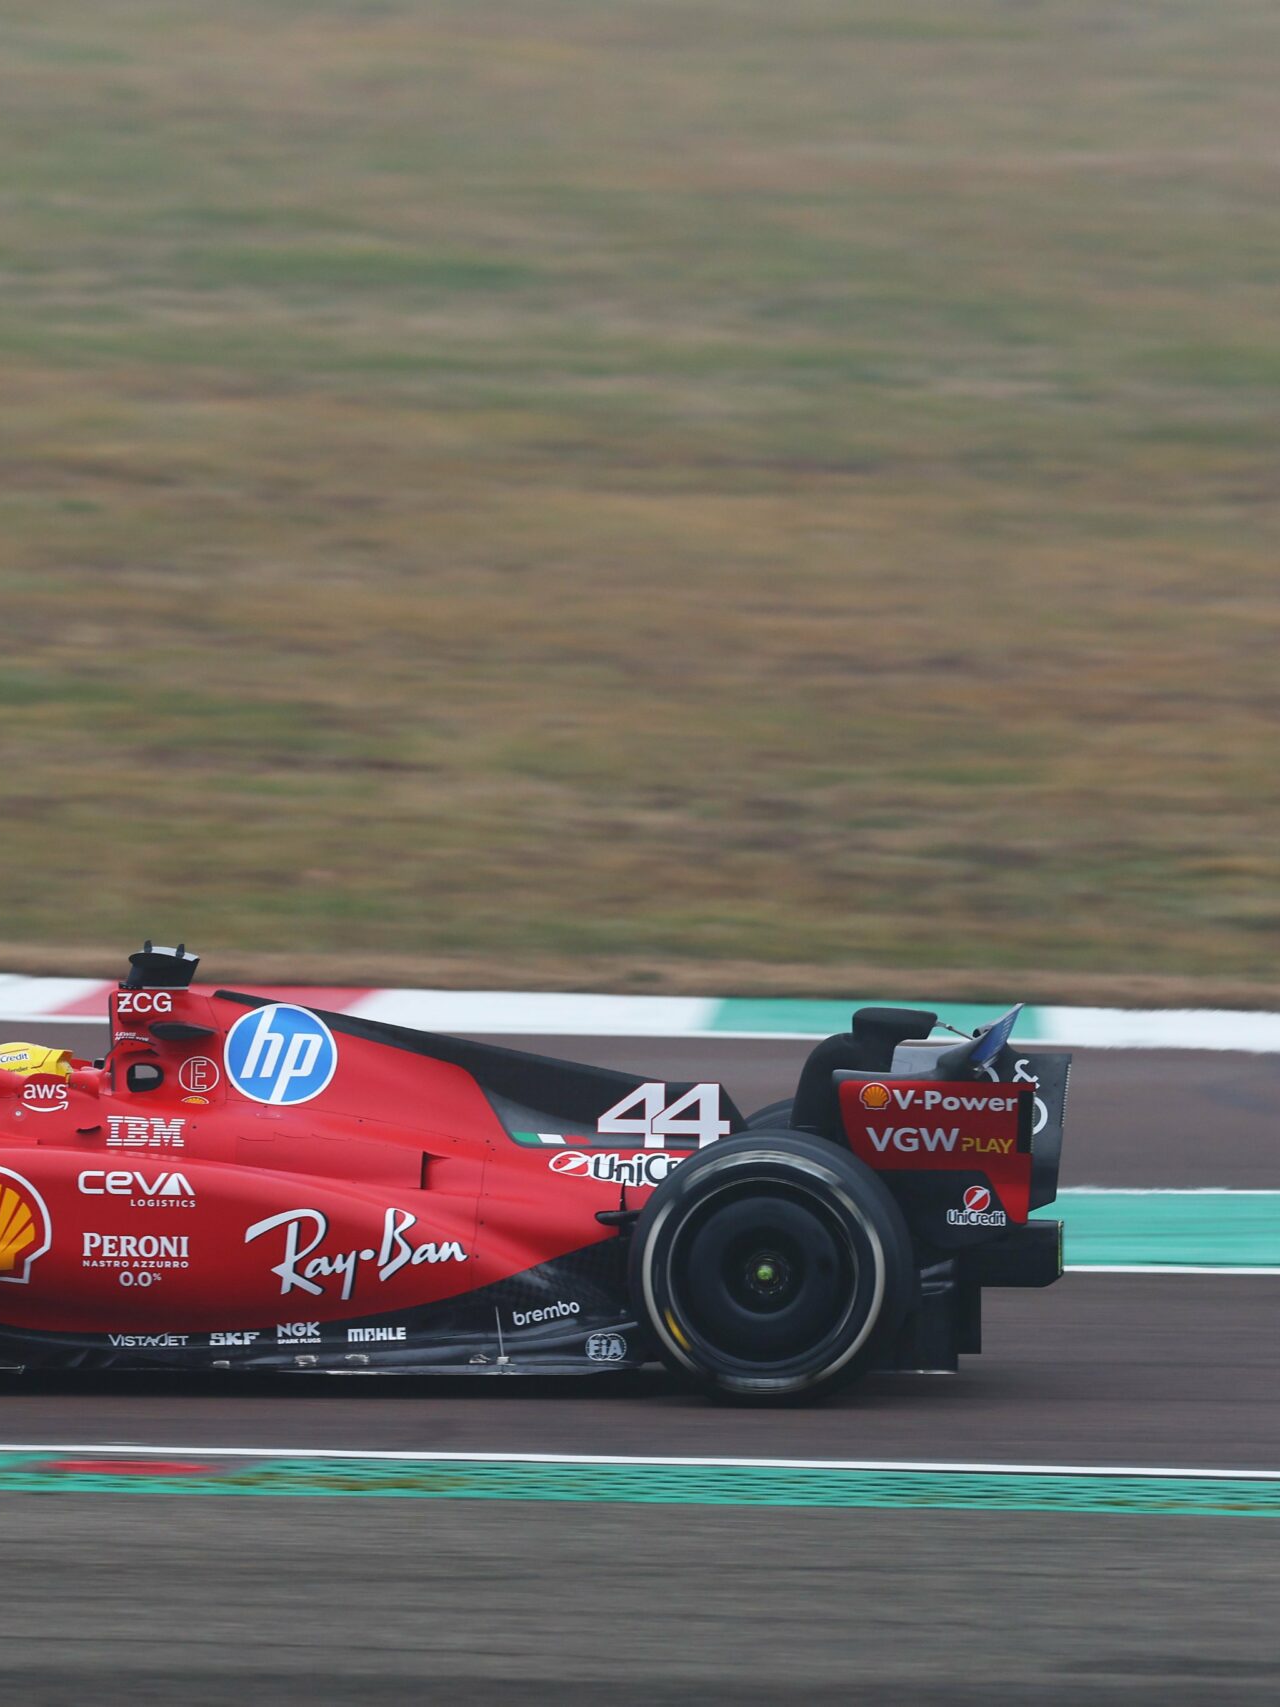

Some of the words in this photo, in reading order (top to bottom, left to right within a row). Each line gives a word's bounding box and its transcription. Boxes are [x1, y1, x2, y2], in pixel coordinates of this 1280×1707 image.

[239, 1004, 325, 1102] hp
[23, 1083, 68, 1100] aws
[893, 1089, 1018, 1112] V-Power
[597, 1081, 731, 1149] 44
[106, 1115, 186, 1147] IBM
[866, 1127, 960, 1152] VGW
[962, 1137, 1014, 1154] PLAY
[130, 1199, 196, 1208] LOGISTICS
[946, 1208, 1007, 1227] UniCredit
[82, 1232, 190, 1258] PERONI
[82, 1260, 129, 1268] NASTRO
[132, 1260, 190, 1268] AZZURRO
[118, 1271, 162, 1287] 0.0%
[512, 1300, 580, 1326] brembo
[209, 1332, 260, 1346] SKF
[277, 1321, 321, 1338] NGK
[348, 1327, 407, 1342] MAHLE
